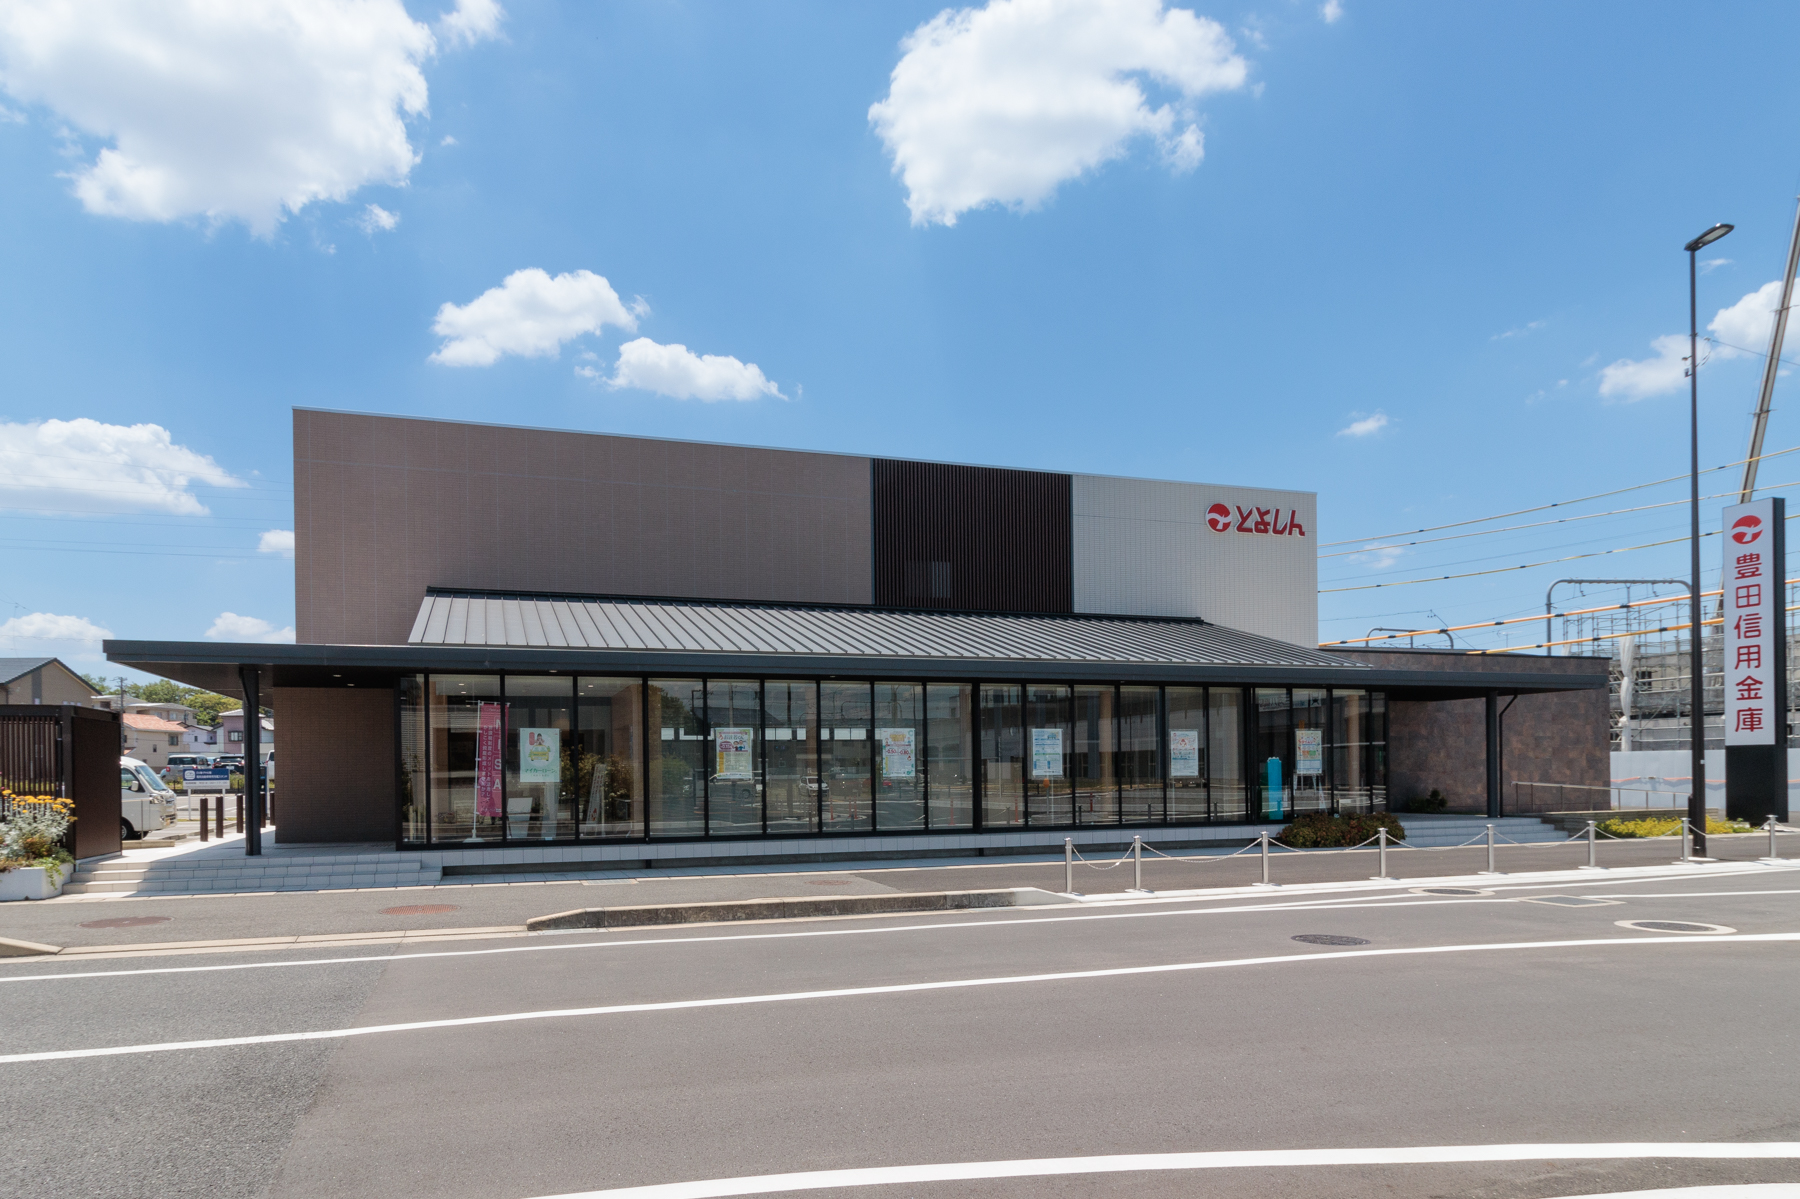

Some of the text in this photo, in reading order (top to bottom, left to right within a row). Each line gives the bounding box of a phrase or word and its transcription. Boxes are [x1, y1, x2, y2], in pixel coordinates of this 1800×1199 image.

[1234, 505, 1306, 537] とよしん
[1734, 552, 1764, 732] 豊田信用金庫
